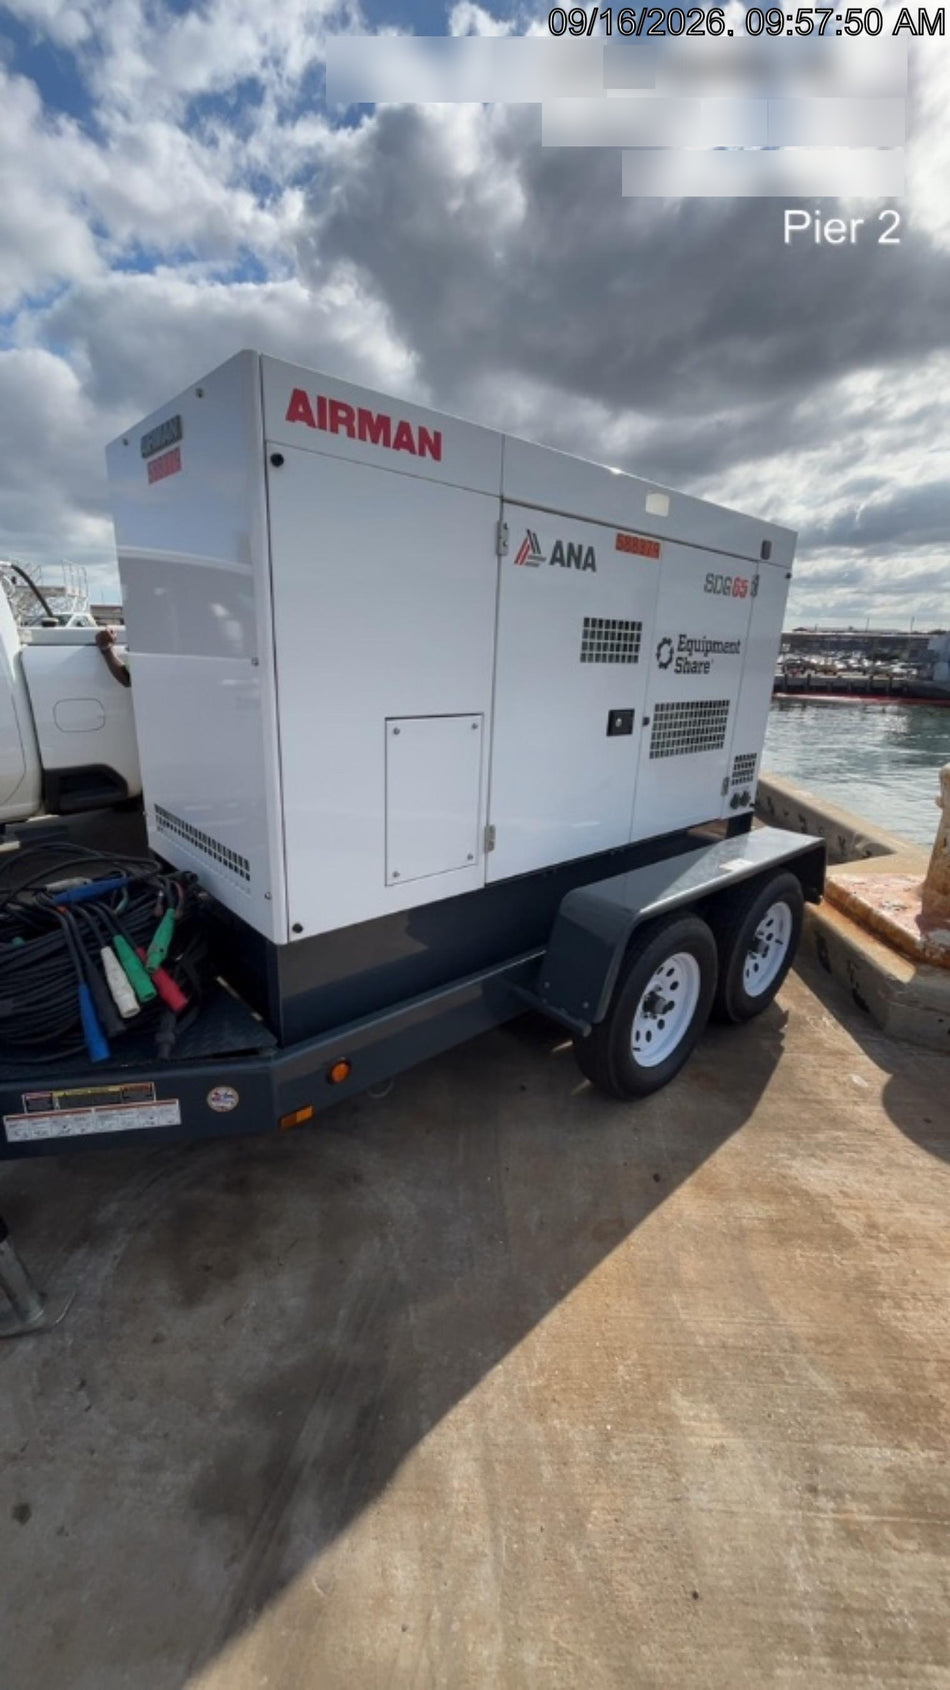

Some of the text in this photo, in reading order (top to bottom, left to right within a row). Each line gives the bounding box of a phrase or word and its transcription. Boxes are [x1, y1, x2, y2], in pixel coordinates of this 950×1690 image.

[286, 388, 442, 462] AIRMAN
[549, 540, 597, 573] ANA
[677, 634, 742, 657] Equipment
[674, 656, 711, 675] Share
